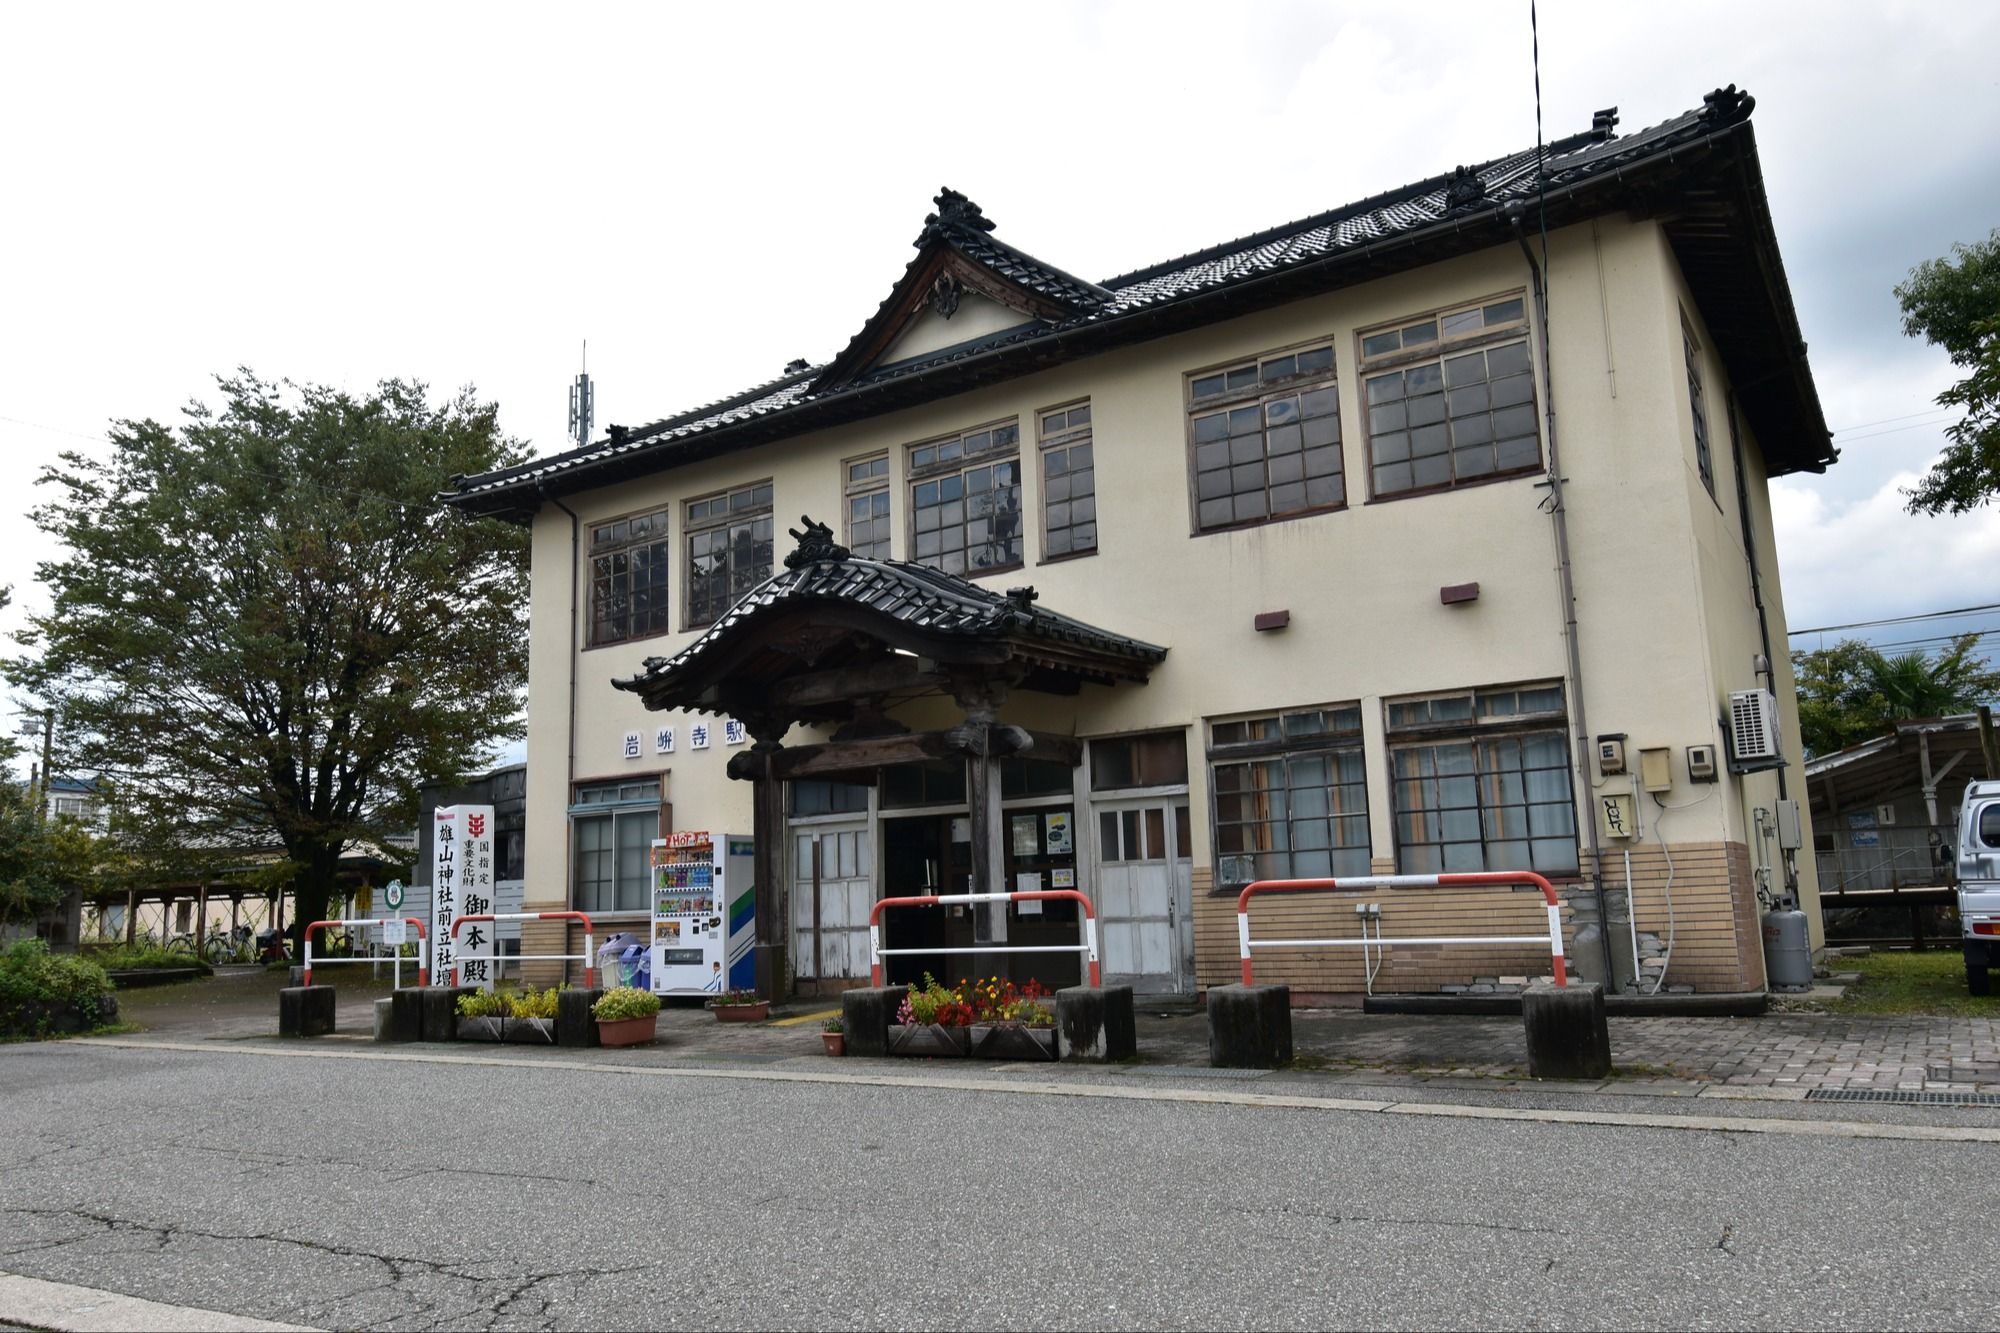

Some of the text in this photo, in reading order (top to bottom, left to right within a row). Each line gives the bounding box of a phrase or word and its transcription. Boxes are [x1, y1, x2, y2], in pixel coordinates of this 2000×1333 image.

[625, 721, 742, 755] 岩峅寺駅
[479, 841, 489, 885] 国指定
[672, 834, 692, 847] HOT
[463, 840, 475, 887] 重要文化財
[436, 824, 454, 986] 雄山神社前立社壇
[463, 893, 489, 983] 御本殿
